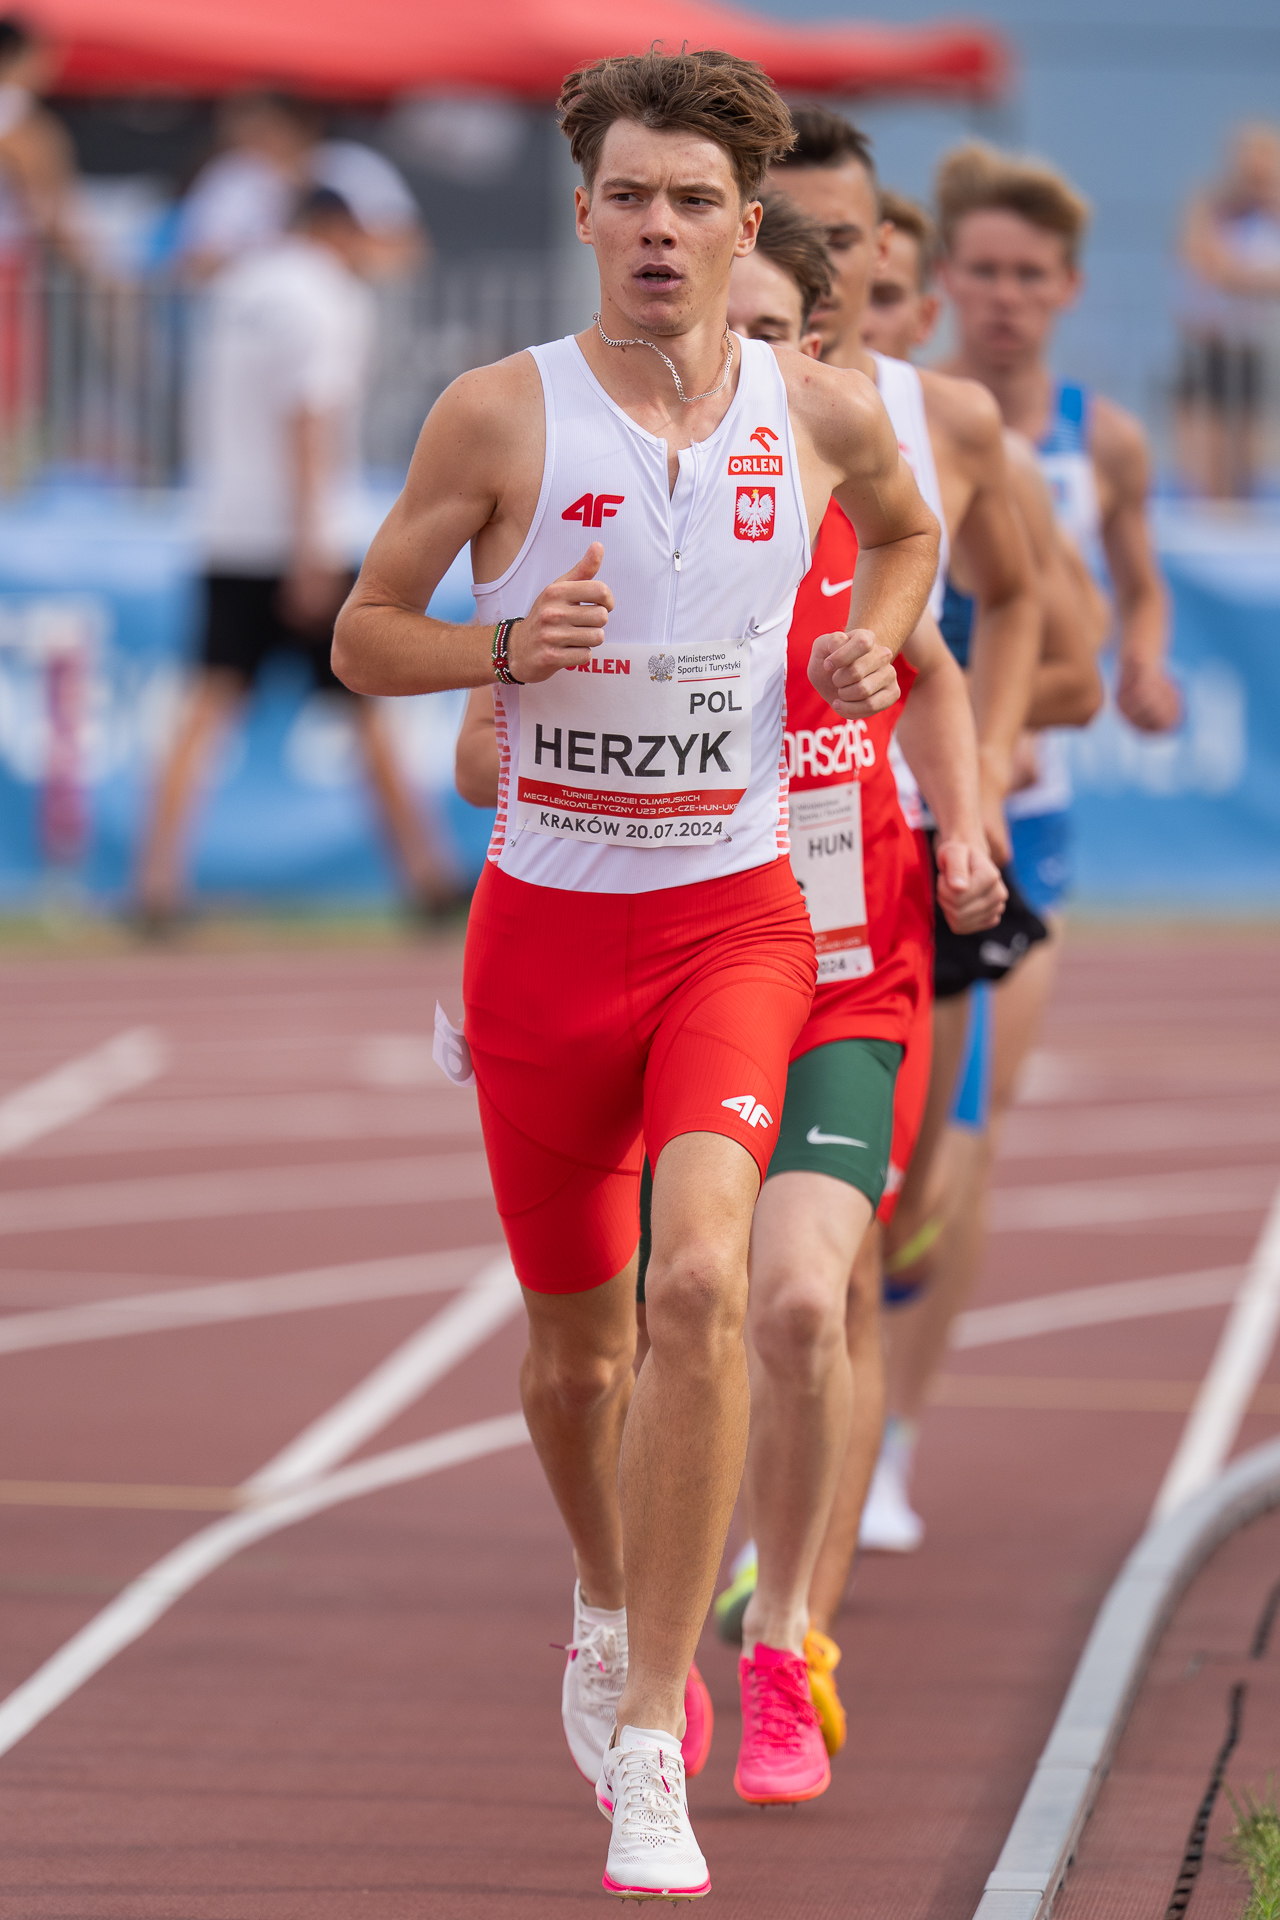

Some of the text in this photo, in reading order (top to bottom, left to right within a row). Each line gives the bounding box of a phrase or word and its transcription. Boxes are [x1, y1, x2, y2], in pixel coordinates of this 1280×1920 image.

[730, 458, 779, 473] ORLEN
[561, 492, 625, 528] 4F
[677, 653, 726, 664] Ministerstwo
[677, 665, 704, 675] Sportu
[708, 660, 741, 672] Turystyki
[689, 689, 743, 715] POL
[534, 723, 732, 778] HERZYK
[523, 792, 548, 802] MECZ
[549, 796, 634, 814] LEKKOATLETYCZNY
[635, 807, 657, 815] U23
[561, 789, 701, 805] TURNIEJ NADZIEI OLIMPIJSKICH
[539, 811, 723, 840] KRAKÓW 20.07.2024
[808, 831, 853, 859] HUN
[721, 1094, 774, 1129] 4F
